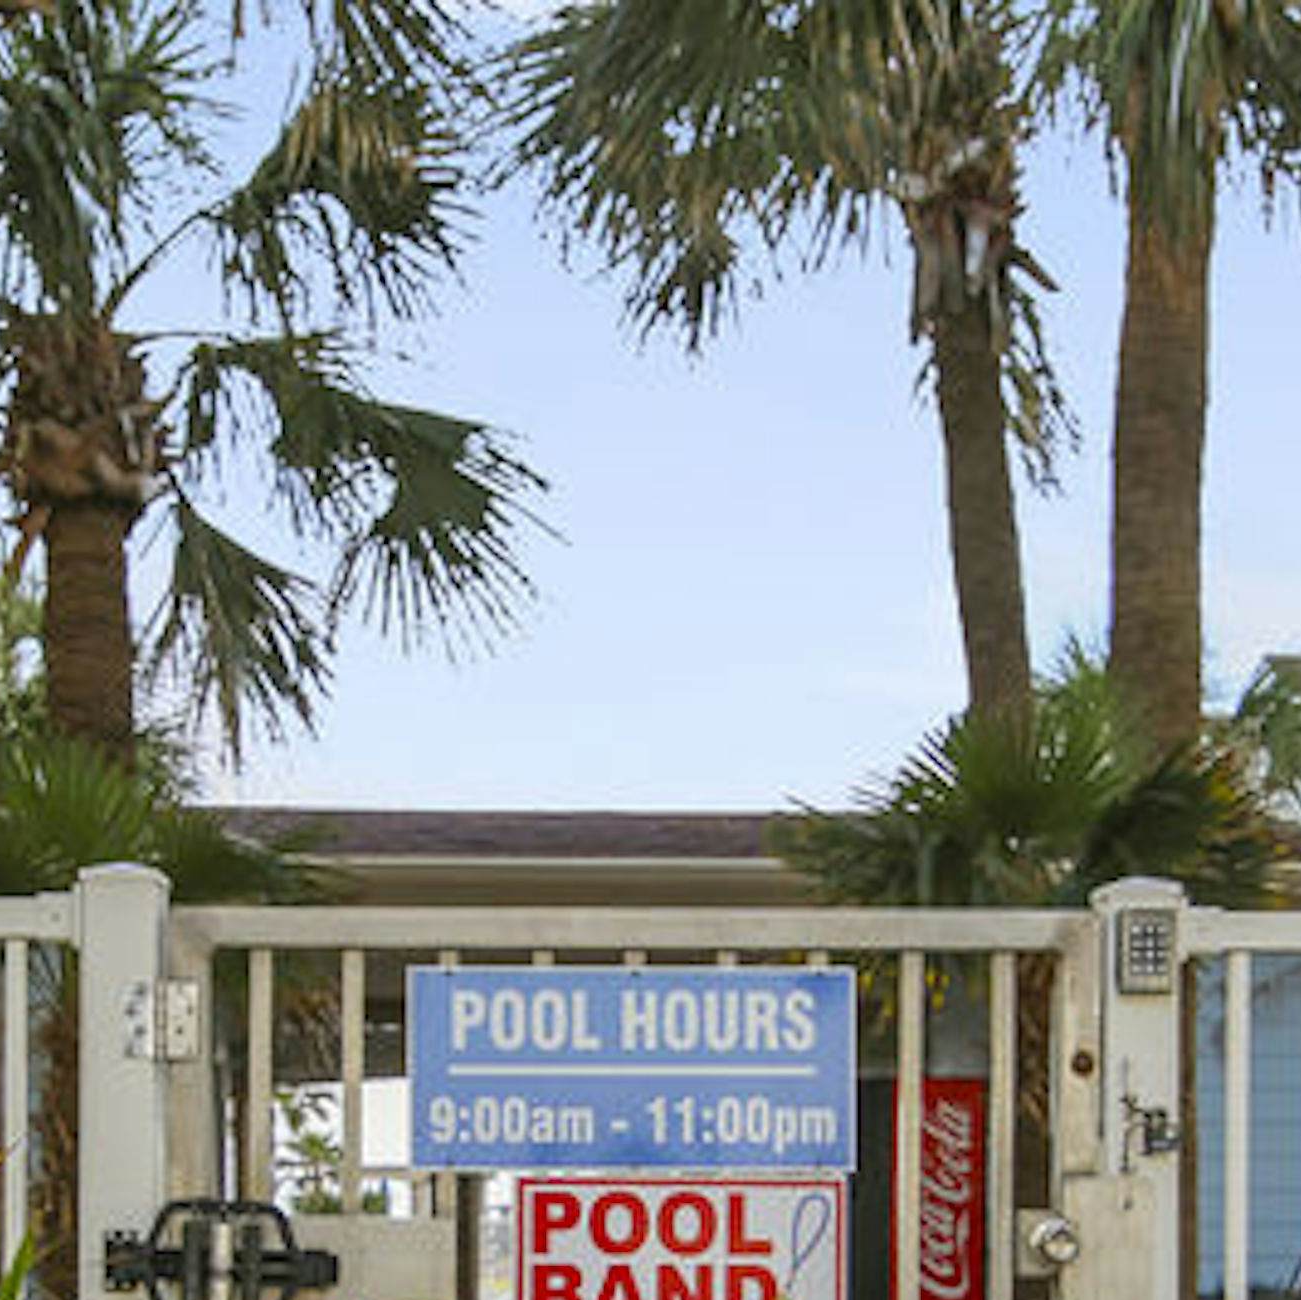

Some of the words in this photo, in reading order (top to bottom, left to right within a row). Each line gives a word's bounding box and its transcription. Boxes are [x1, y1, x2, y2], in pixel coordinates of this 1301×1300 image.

[451, 988, 600, 1052] POOL
[619, 988, 817, 1052] HOURS
[427, 1096, 596, 1145] 9:00am
[647, 1096, 838, 1153] 11:00pm
[531, 1191, 773, 1255] POOL
